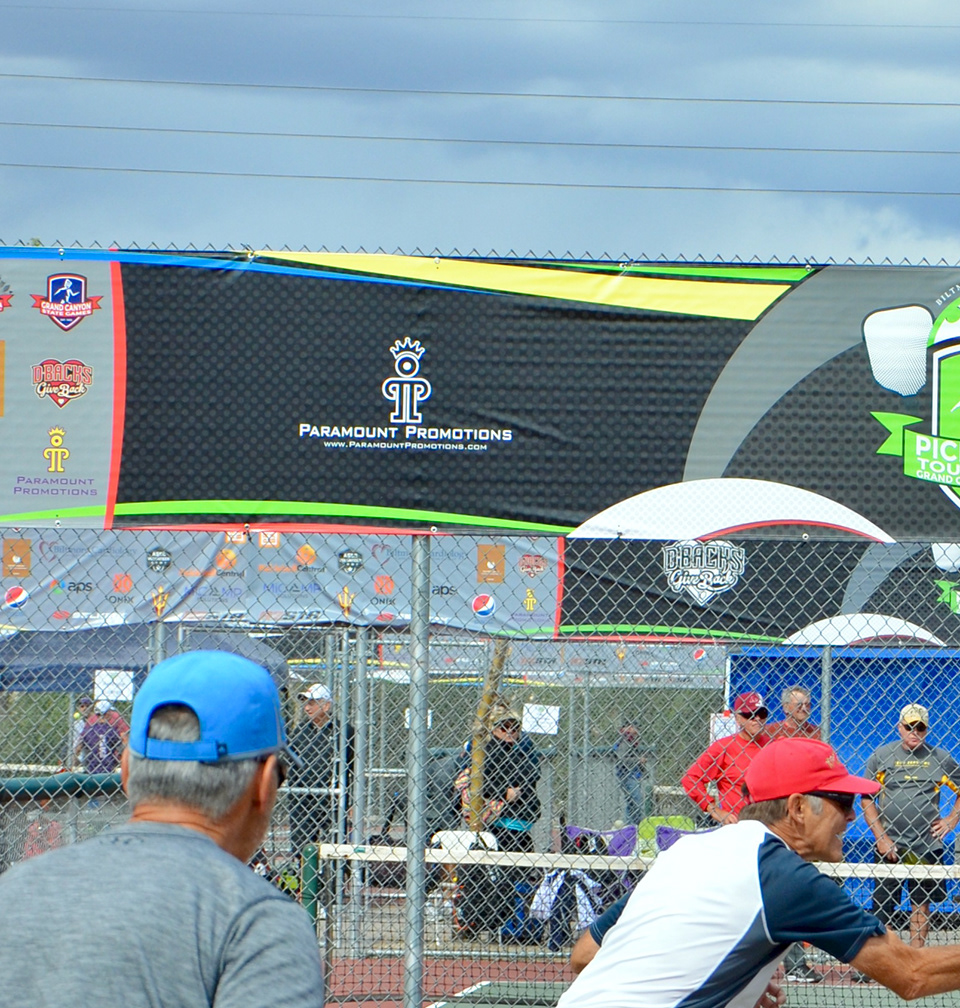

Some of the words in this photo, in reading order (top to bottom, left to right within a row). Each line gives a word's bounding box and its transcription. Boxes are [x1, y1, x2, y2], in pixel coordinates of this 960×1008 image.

[41, 301, 64, 311] GRAND
[64, 302, 92, 312] CANYON
[36, 382, 58, 398] Give
[58, 382, 86, 398] Back
[299, 423, 398, 439] PARAMOUNT
[405, 425, 512, 441] PROMOTIONS
[16, 476, 94, 486] PARAMOUNT
[916, 470, 953, 484] GRAND
[14, 486, 98, 496] PROMOTIONS
[671, 570, 700, 590] Give
[697, 570, 735, 592] Back
[68, 582, 92, 593] aps
[432, 585, 457, 596] aps
[370, 597, 396, 606] ONIX
